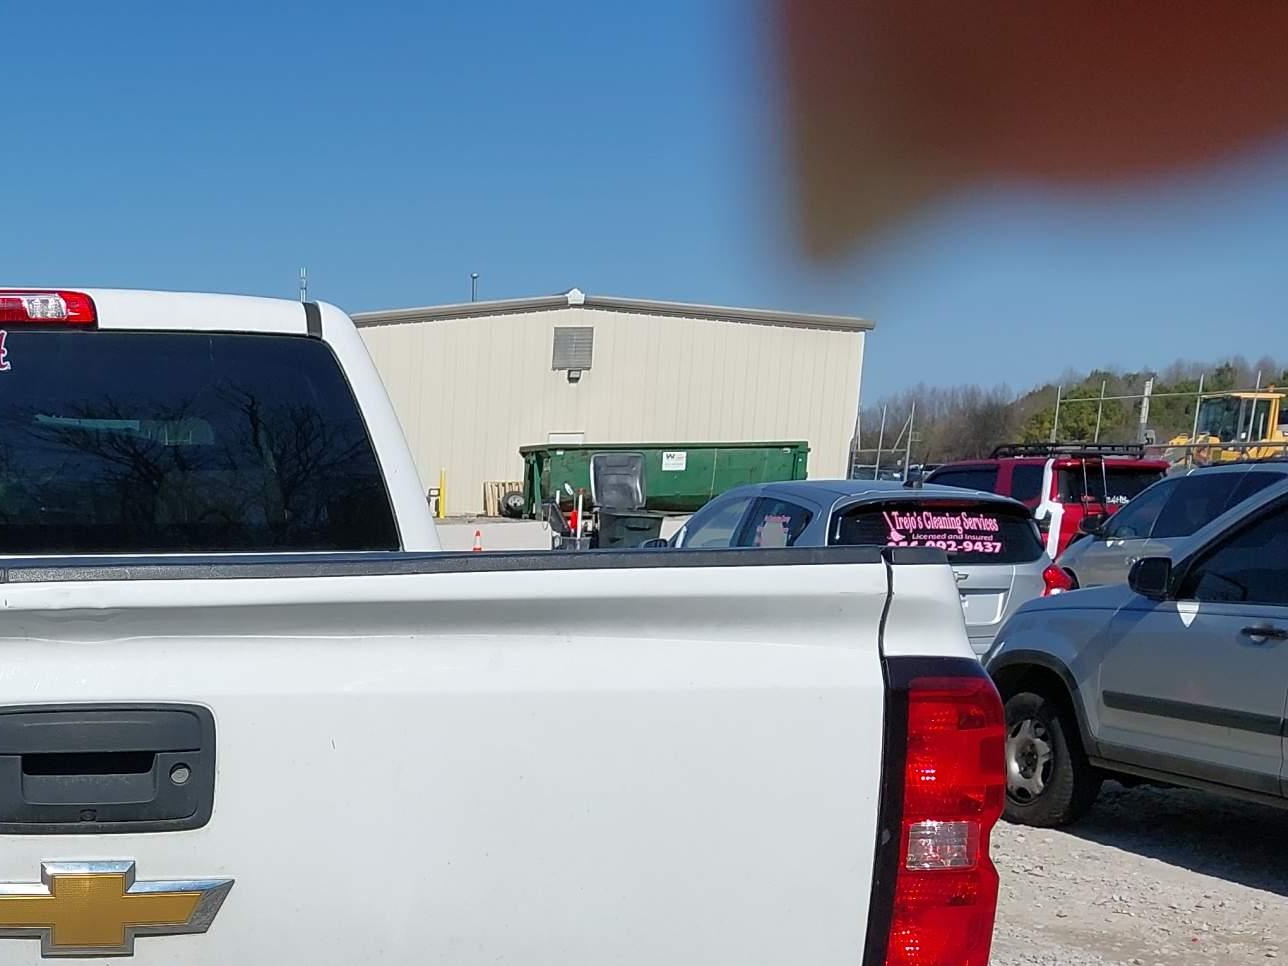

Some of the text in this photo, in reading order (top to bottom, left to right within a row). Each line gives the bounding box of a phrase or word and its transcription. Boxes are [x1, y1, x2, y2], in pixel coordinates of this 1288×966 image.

[892, 511, 999, 534] Trejo's Cleaning Services
[964, 533, 994, 541] Insured
